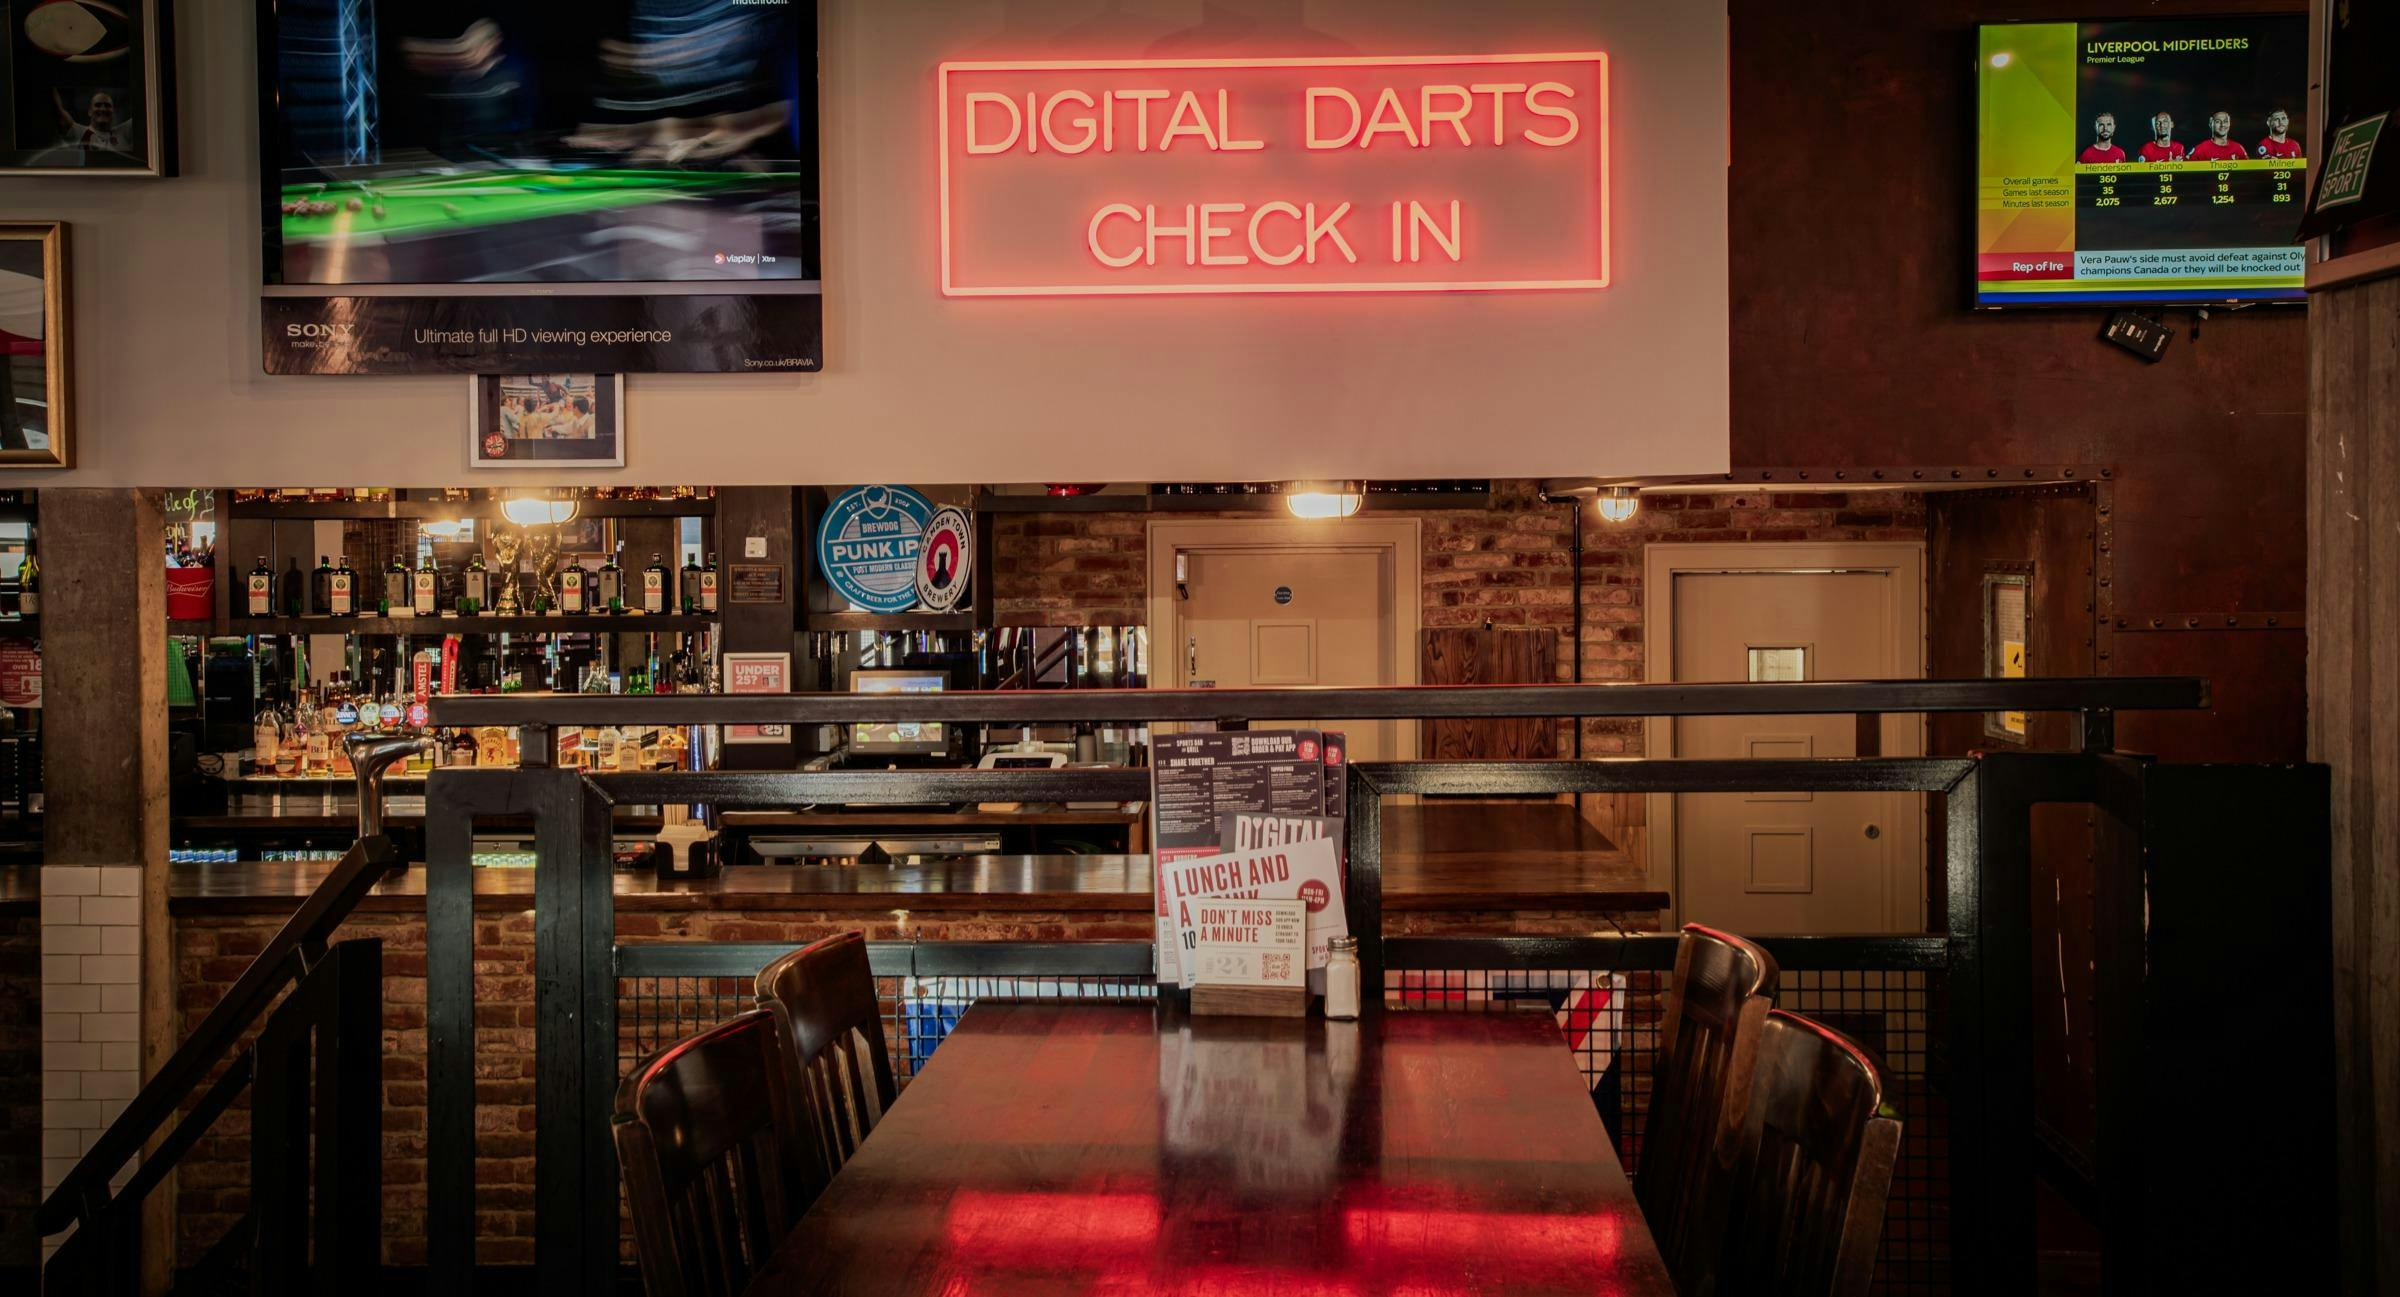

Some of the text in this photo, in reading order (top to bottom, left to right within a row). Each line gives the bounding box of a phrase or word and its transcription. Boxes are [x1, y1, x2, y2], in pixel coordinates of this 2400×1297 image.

[2087, 38, 2249, 54] LIVERPOOL MIDFIELDERS
[2117, 55, 2145, 64] League
[966, 82, 1579, 154] DIGITAL DARTS
[2336, 133, 2354, 156] WE
[2085, 160, 2295, 172] Henderson Fabinho Thiago Milner
[2334, 147, 2369, 175] LOVE
[2003, 171, 2291, 187] Overall games 360 151 67 230
[2322, 170, 2362, 199] SPORT
[2003, 189, 2027, 197] Games
[2044, 188, 2069, 196] season
[2102, 186, 2114, 195] 35
[2160, 185, 2172, 194] 36
[2218, 184, 2229, 192] 18
[2277, 183, 2287, 191] 31
[2003, 200, 2030, 208] Minutes
[2044, 199, 2069, 207] season
[2096, 198, 2120, 207] 2,075
[2154, 197, 2177, 205] 2,677
[2212, 195, 2234, 204] 1,254
[2273, 194, 2290, 202] 893
[1088, 200, 1460, 267] CHECK IN
[726, 254, 776, 264] viaplay Xtra
[2080, 251, 2305, 264] Vera Pauw's side must avoid defeat against Oly
[2013, 261, 2064, 273] Rep of Ire
[2080, 263, 2301, 276] champions Canada or they will be knocked out
[287, 323, 354, 337] SONY
[414, 328, 672, 346] Ultimate full HD viewing experience
[744, 358, 814, 368] Sony.co.uk/BRAVIA
[862, 521, 899, 534] BREWDOG
[922, 516, 966, 553] CAMDEN TOWN
[832, 539, 919, 562] PUNK IP
[852, 565, 868, 575] POST
[869, 563, 893, 574] MODERN
[167, 583, 209, 593] Budweiser
[844, 581, 911, 604] CRAFT BEER FOR THE
[923, 581, 958, 602] BREWERY
[29, 659, 42, 671] 18
[735, 665, 780, 675] UNDER
[418, 663, 427, 697] AMSTEL
[735, 675, 758, 685] 25?
[766, 724, 783, 735] 25
[1176, 739, 1193, 747] SPORTS
[1251, 736, 1292, 746] DOWNLOAD OUR
[1251, 744, 1269, 754] ORDER
[1275, 744, 1285, 753] PAY
[1285, 743, 1296, 752] APP
[1170, 757, 1215, 767] SHARE TOGETHER
[1173, 853, 1289, 898] LUNCH AND
[1303, 887, 1323, 896] MON-FRI
[1180, 900, 1192, 929] A
[1201, 909, 1273, 926] DON'T MISS
[1200, 927, 1259, 943] A MINUTE
